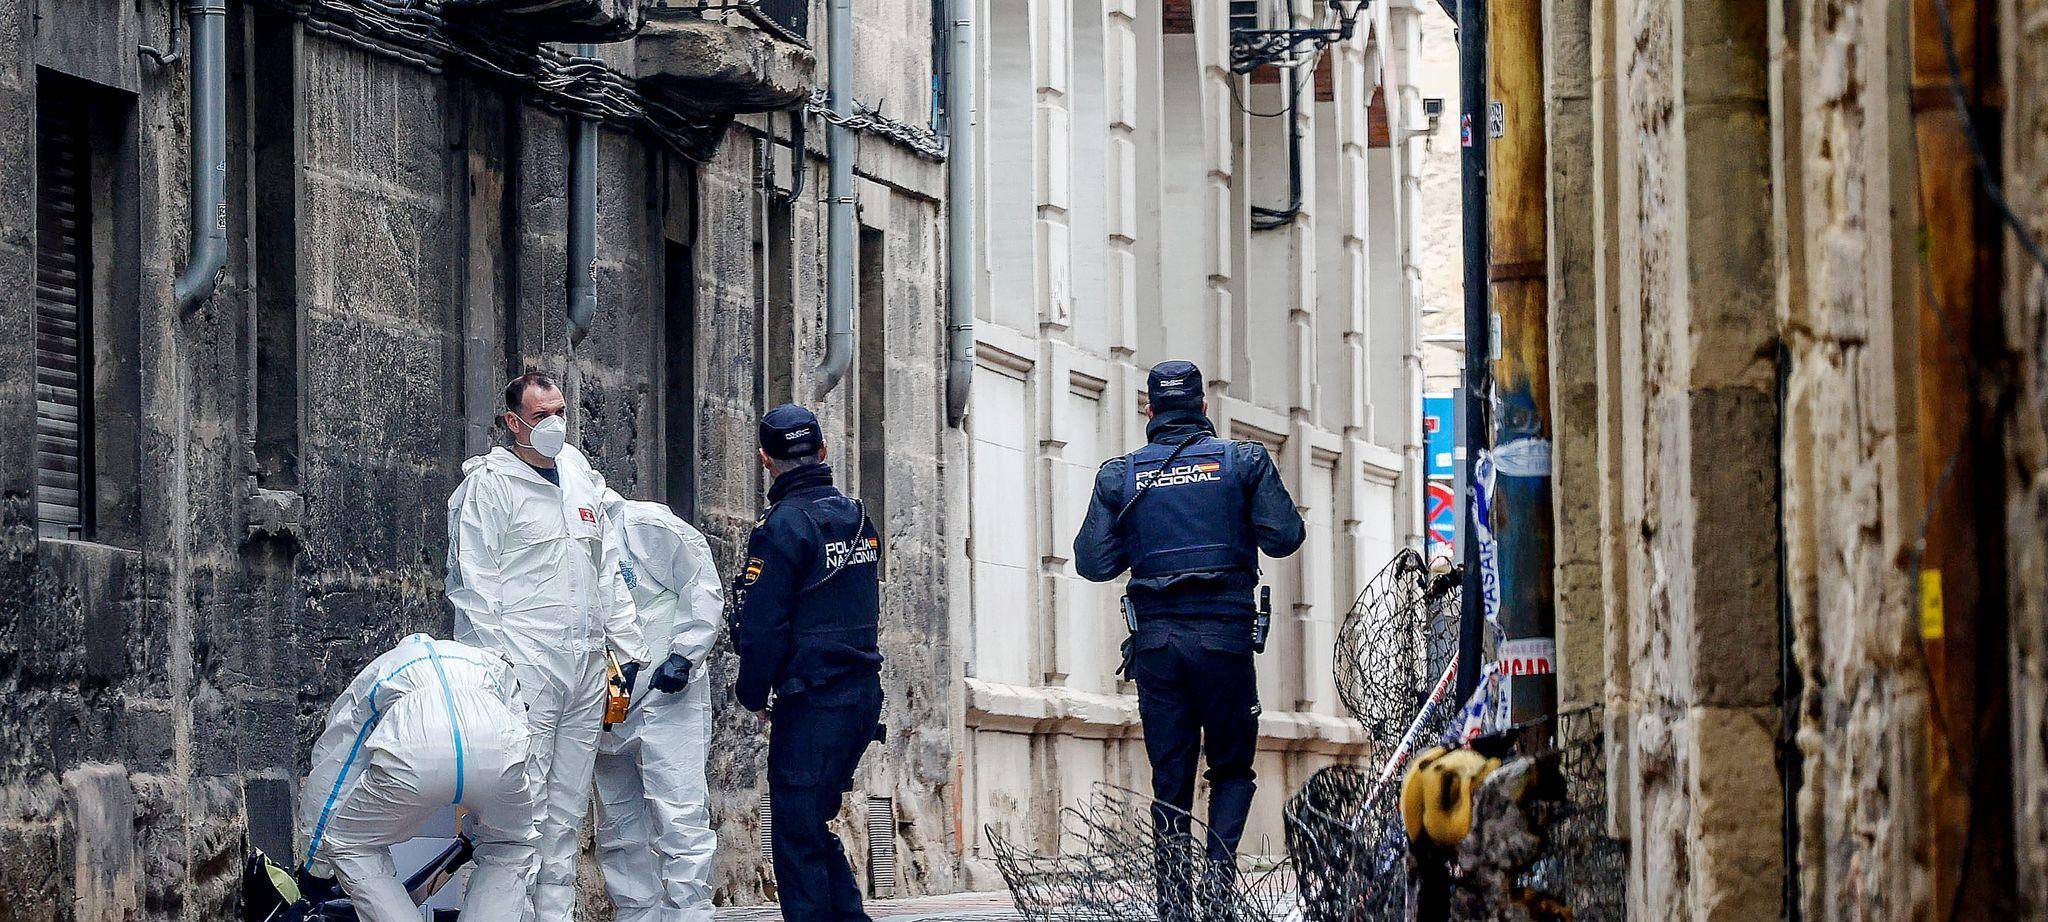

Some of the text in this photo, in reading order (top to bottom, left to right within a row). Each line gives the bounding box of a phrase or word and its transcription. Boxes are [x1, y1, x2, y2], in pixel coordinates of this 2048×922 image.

[1136, 464, 1203, 481] POLICIA
[1136, 472, 1221, 490] NACIONAL
[825, 538, 872, 556] POLIA
